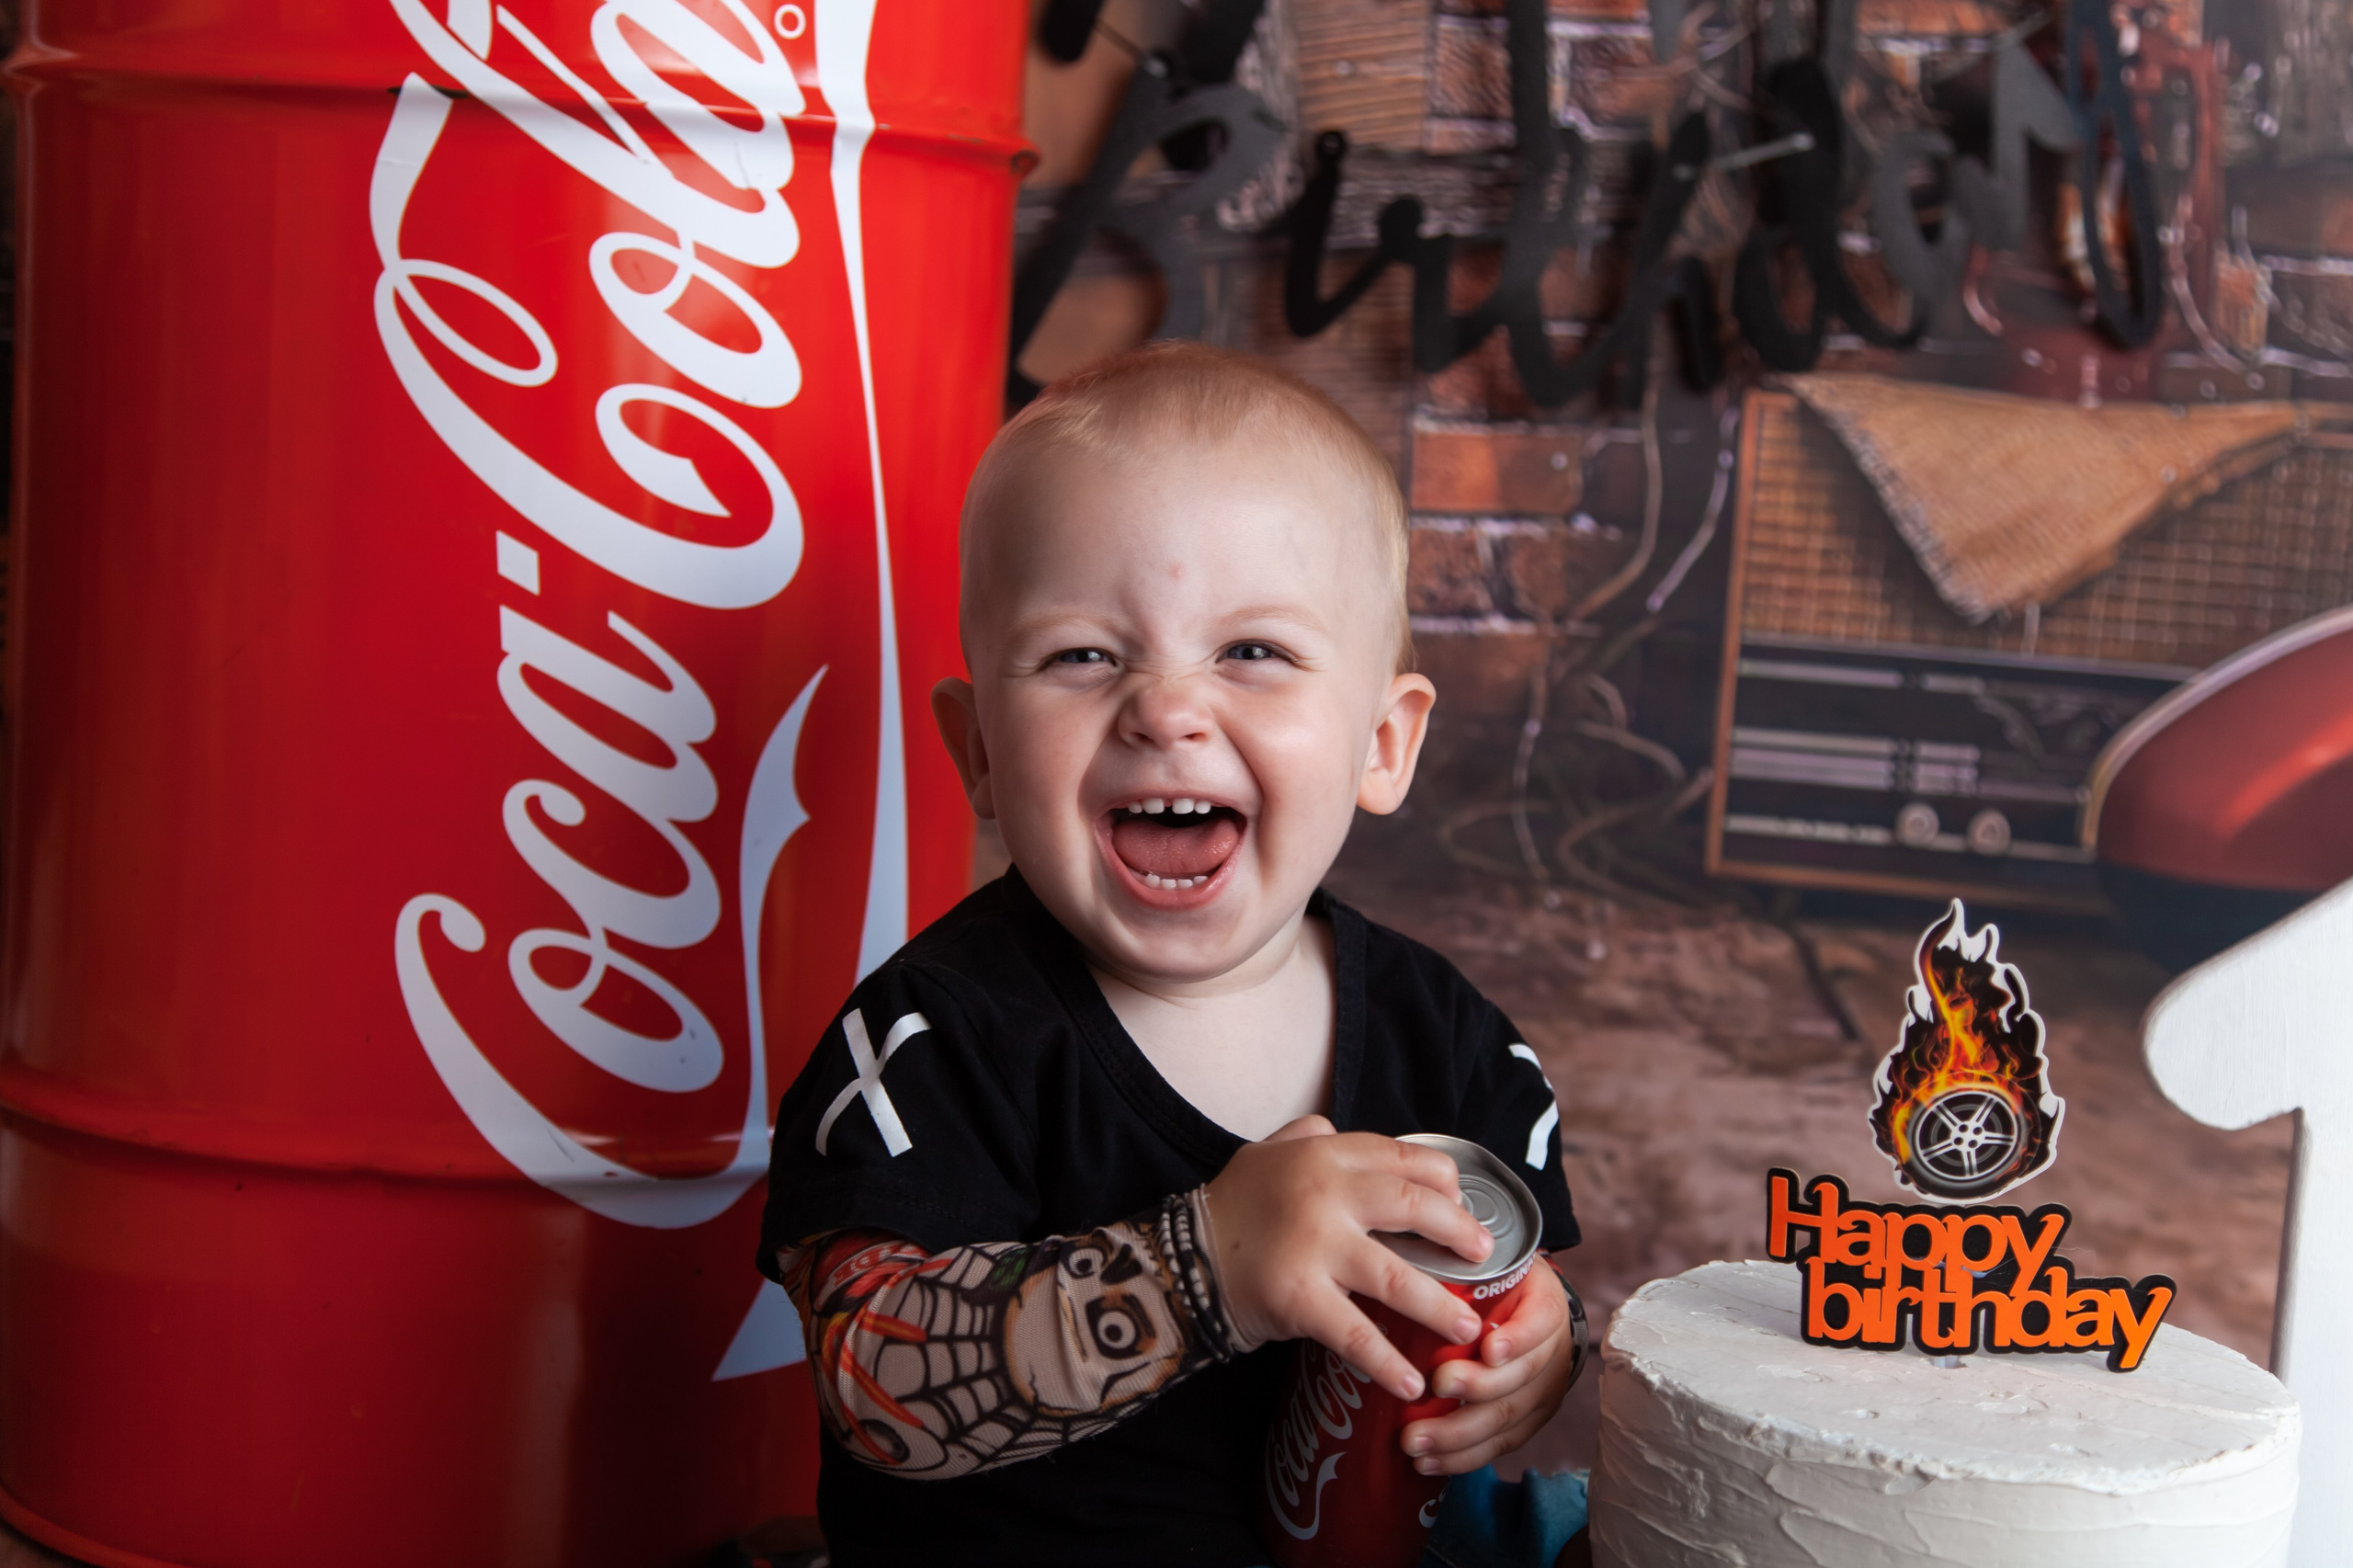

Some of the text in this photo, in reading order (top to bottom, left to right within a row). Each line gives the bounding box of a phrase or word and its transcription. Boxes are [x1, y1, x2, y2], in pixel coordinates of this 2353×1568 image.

[369, 0, 818, 1229] Coca-Cola
[1769, 1176, 2065, 1298] Happy
[1805, 1256, 2173, 1369] birthday
